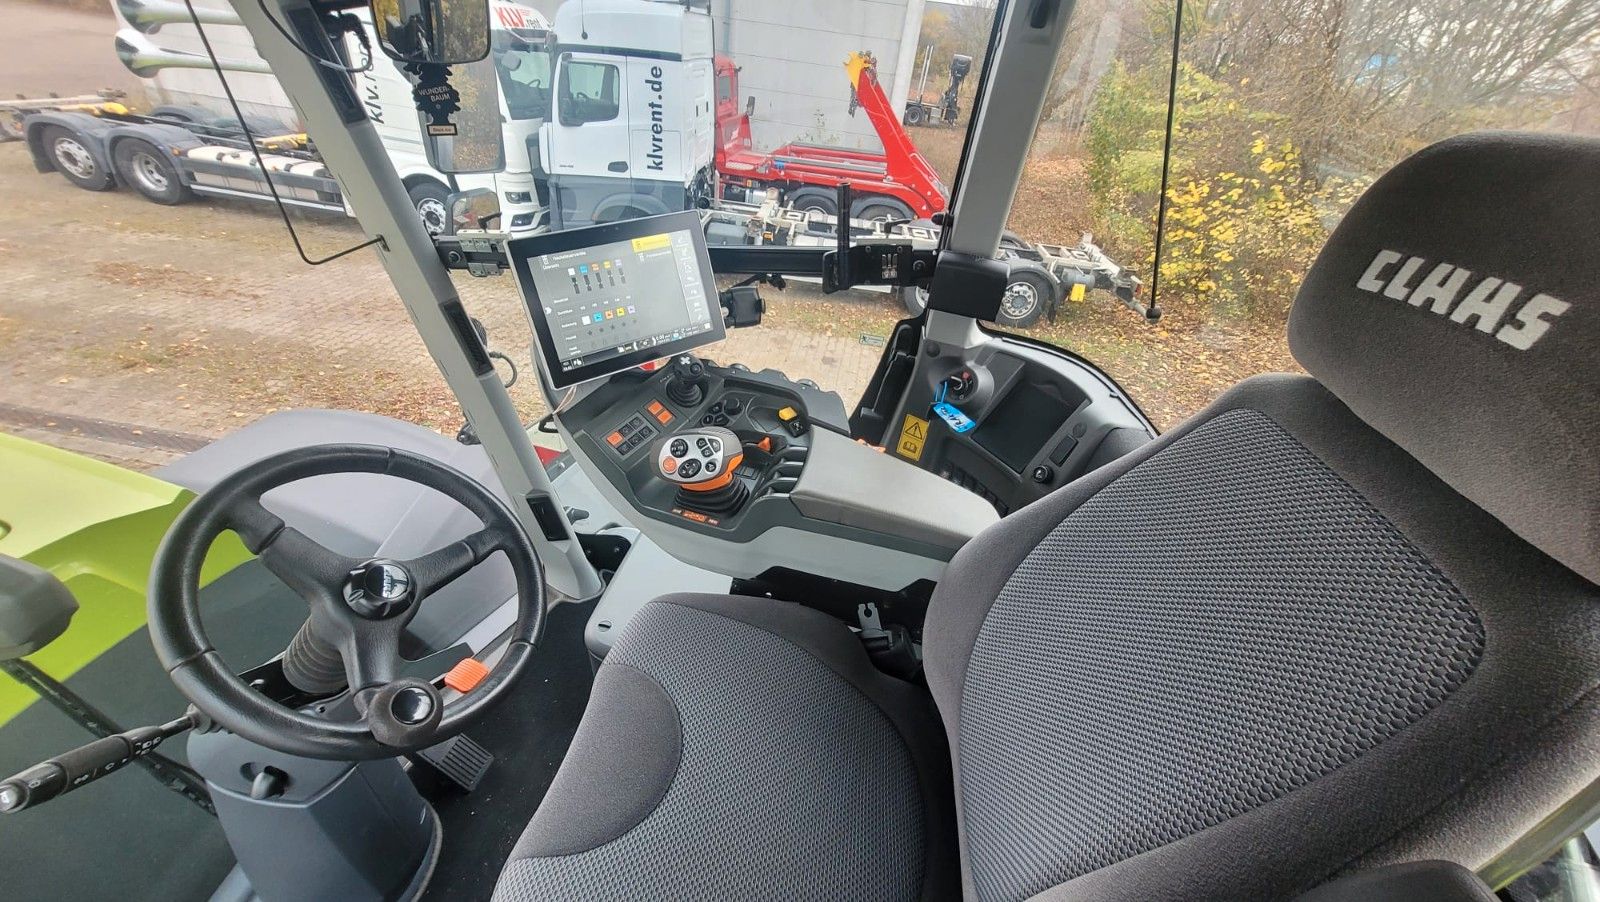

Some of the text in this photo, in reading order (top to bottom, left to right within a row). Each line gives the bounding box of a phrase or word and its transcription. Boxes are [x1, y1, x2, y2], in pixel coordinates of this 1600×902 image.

[430, 93, 450, 103] BAUM
[645, 66, 663, 171] klvrent.de
[1356, 249, 1572, 351] CLAAS
